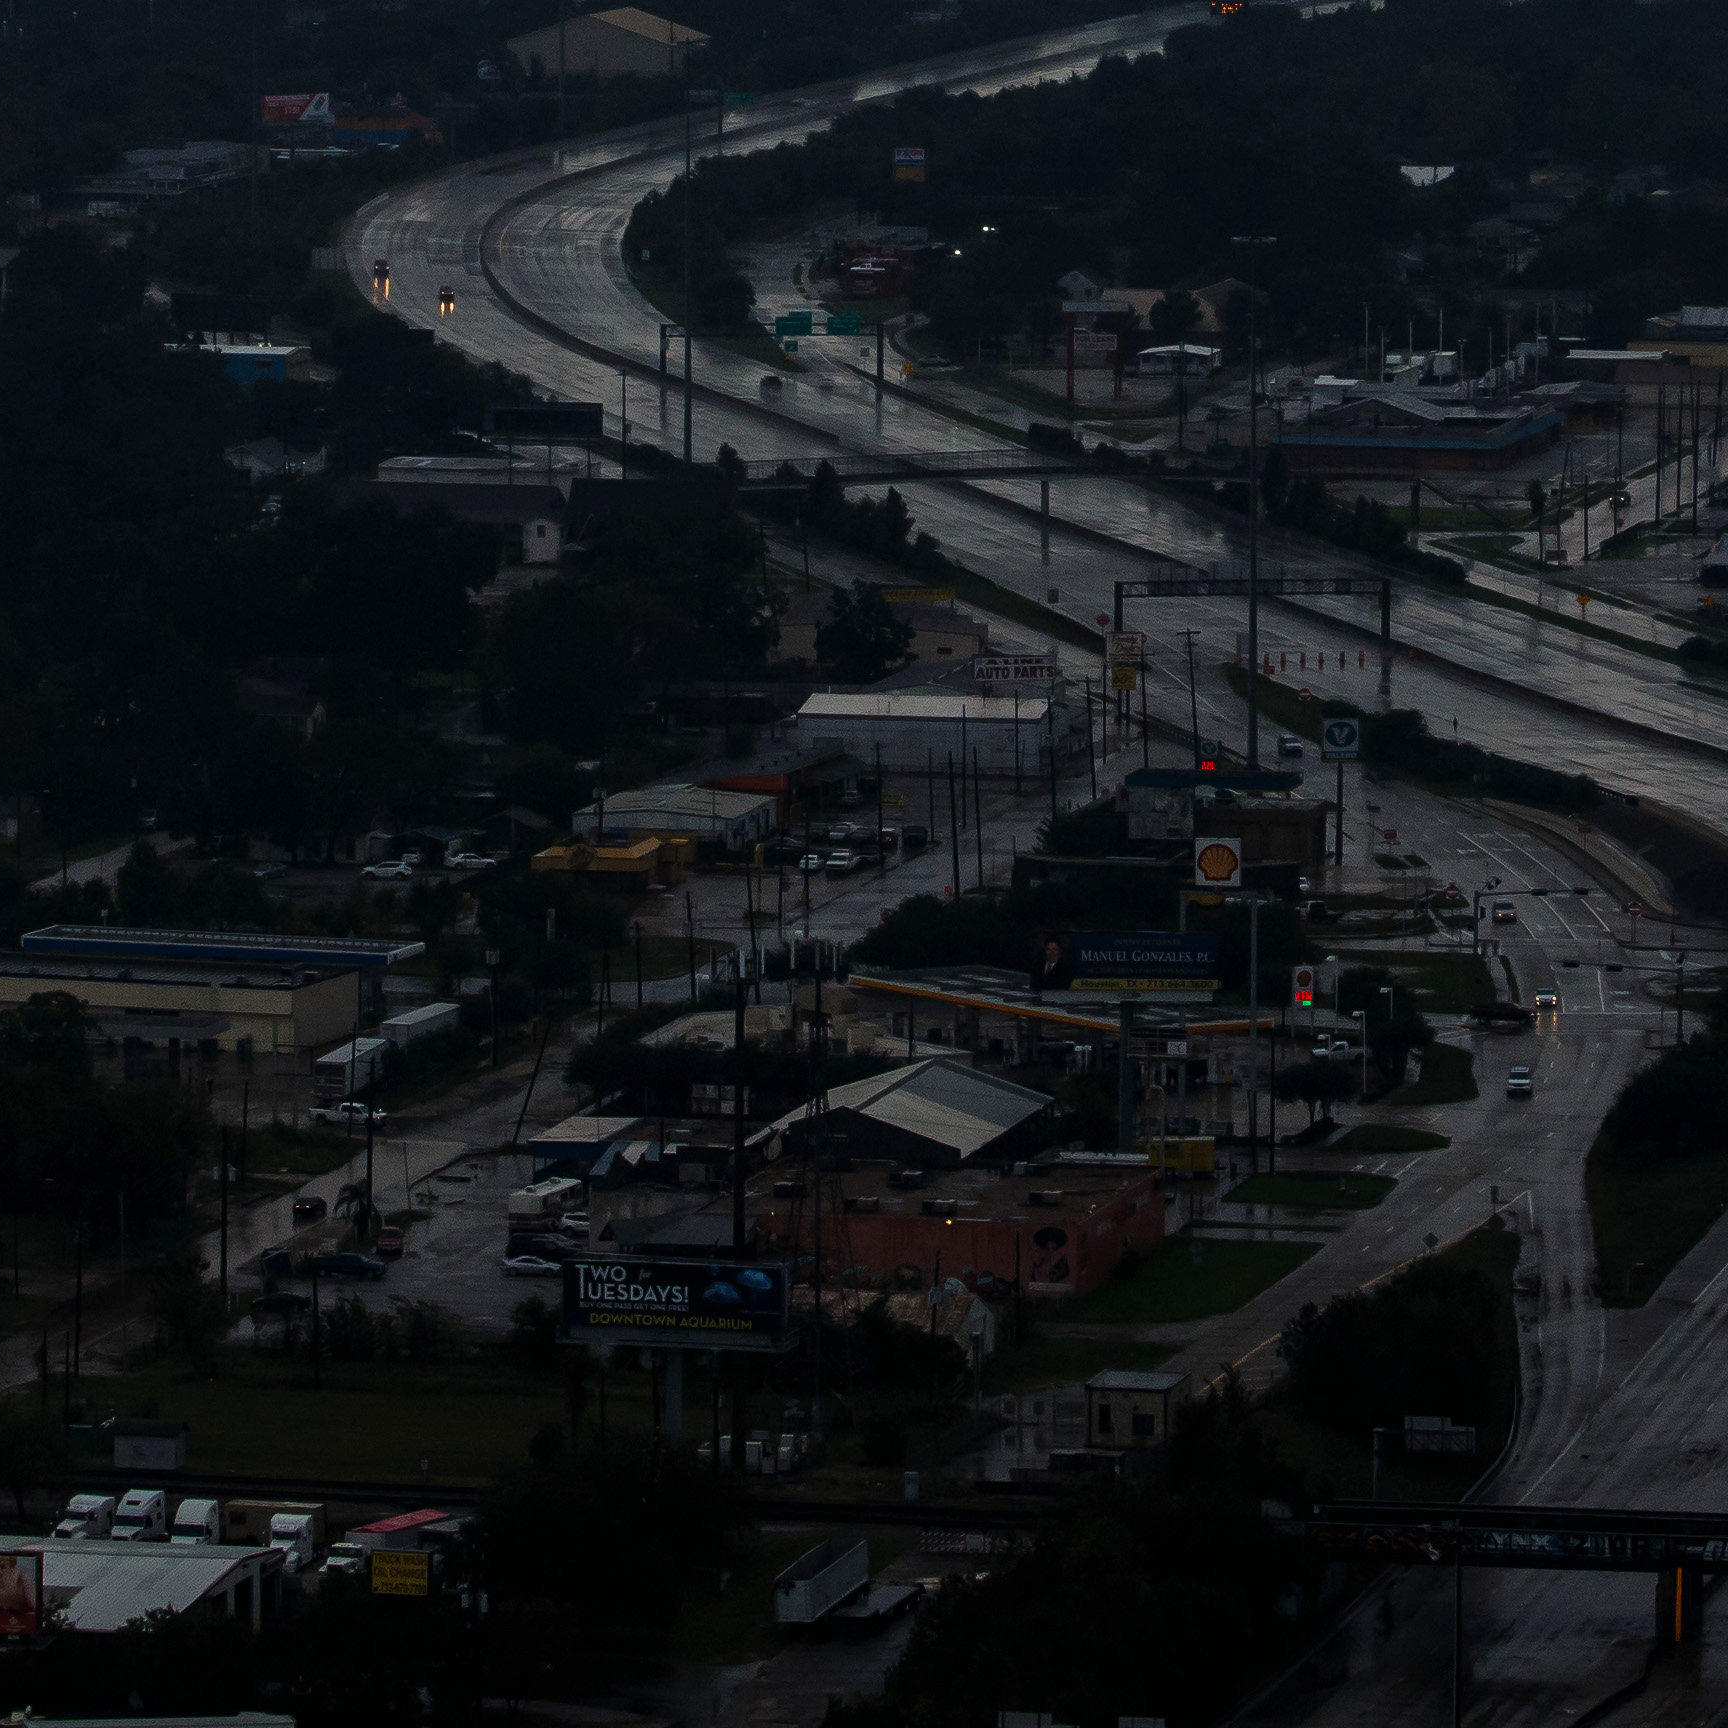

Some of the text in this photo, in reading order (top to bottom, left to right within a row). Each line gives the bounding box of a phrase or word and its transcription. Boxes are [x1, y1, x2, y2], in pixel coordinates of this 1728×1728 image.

[976, 665, 1055, 679] AUTO PARTS
[1081, 949, 1129, 962] MANUEL
[575, 1264, 627, 1283] TWO
[579, 1282, 690, 1303] TUESDAYS!
[589, 1312, 753, 1331] DOWNTOWN AQUARIUM
[374, 1553, 400, 1565] TRUCK
[373, 1565, 426, 1579] OIL CHANGE
